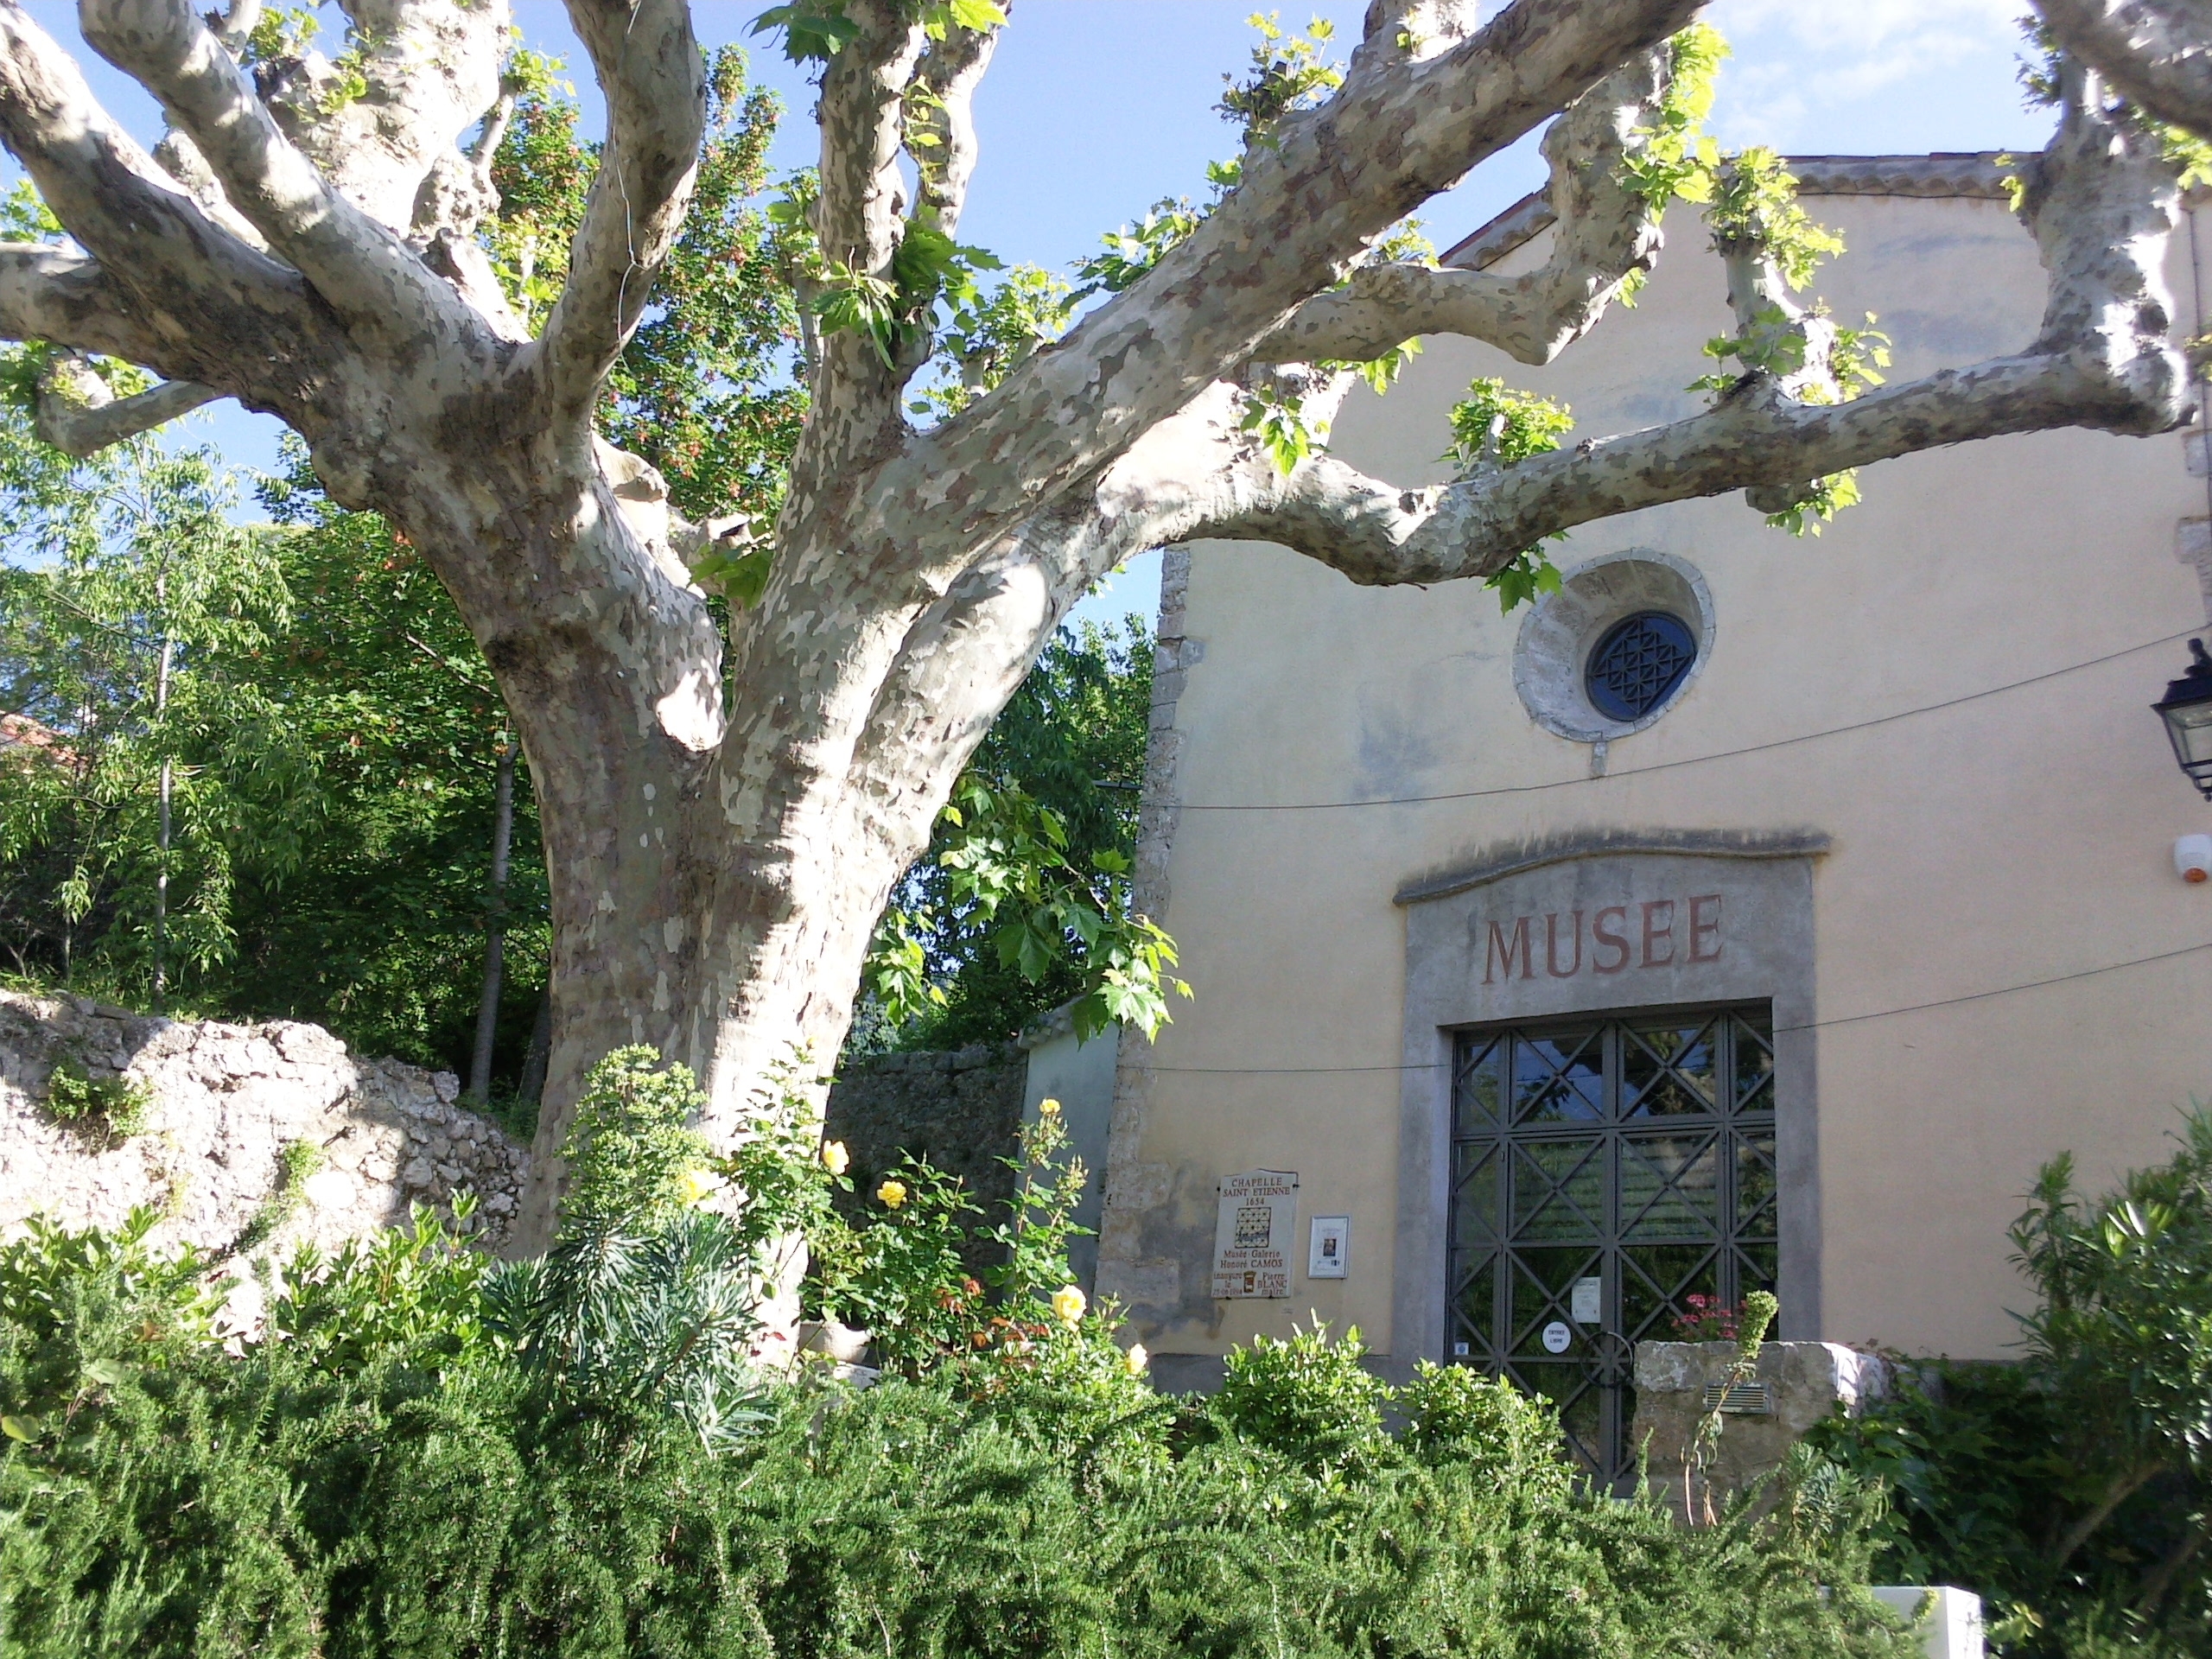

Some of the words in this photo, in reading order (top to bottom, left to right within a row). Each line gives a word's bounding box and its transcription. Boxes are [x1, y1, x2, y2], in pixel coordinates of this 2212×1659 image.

[1482, 893, 1723, 985] MUSEE
[1232, 1177, 1282, 1188] CHAPELLE
[1224, 1188, 1248, 1198] SAINT
[1253, 1186, 1290, 1197] ETIENNE
[1251, 1259, 1282, 1268] CAMOS
[1262, 1272, 1285, 1281] Pierre
[1257, 1280, 1287, 1288] BLANC
